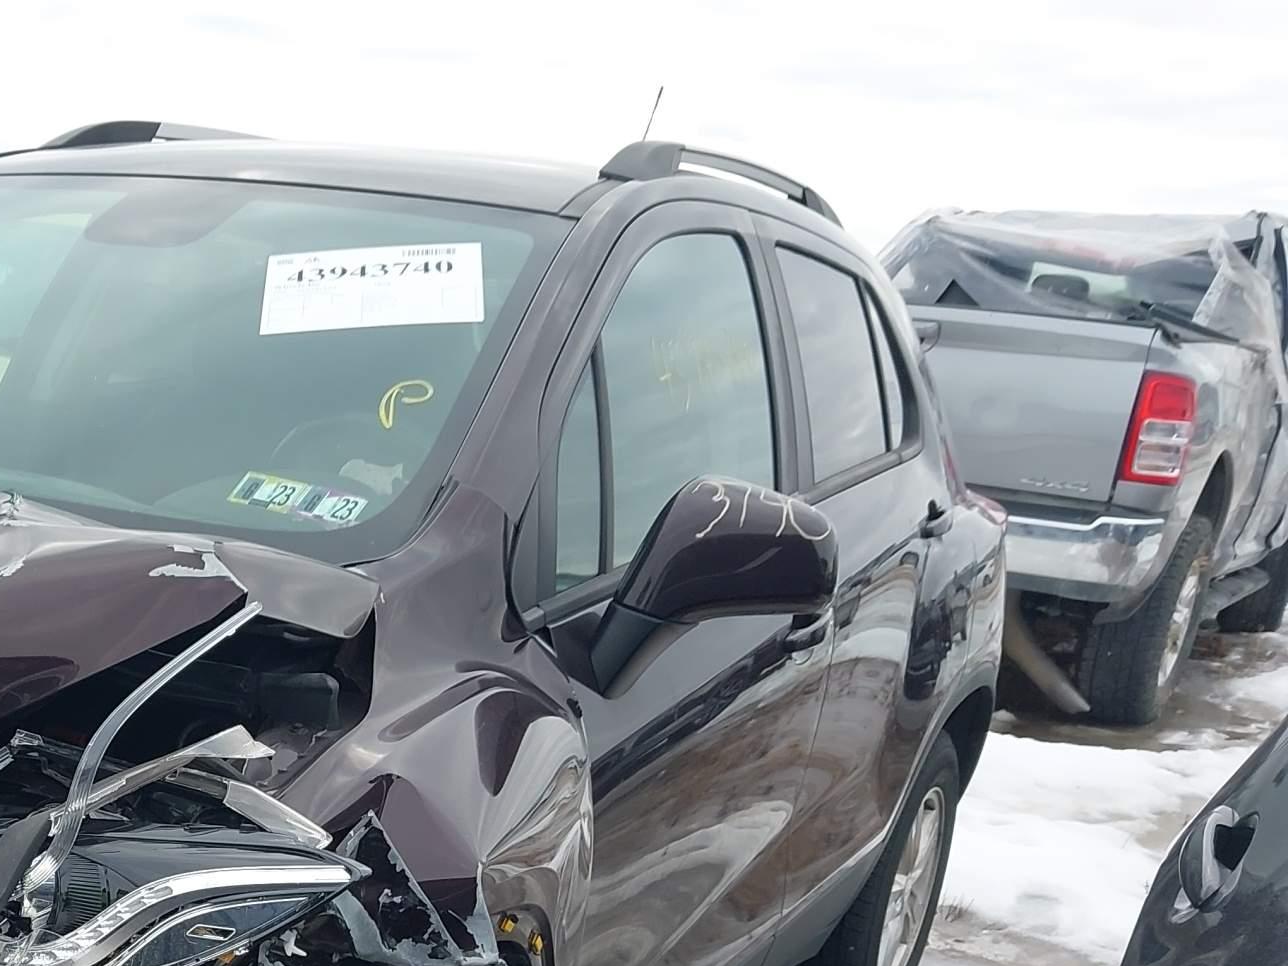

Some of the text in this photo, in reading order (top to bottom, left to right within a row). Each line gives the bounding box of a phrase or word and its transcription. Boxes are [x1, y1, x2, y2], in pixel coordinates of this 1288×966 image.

[287, 259, 454, 283] 43943740
[378, 379, 434, 429] P
[268, 484, 297, 506] 23
[329, 497, 359, 520] 23
